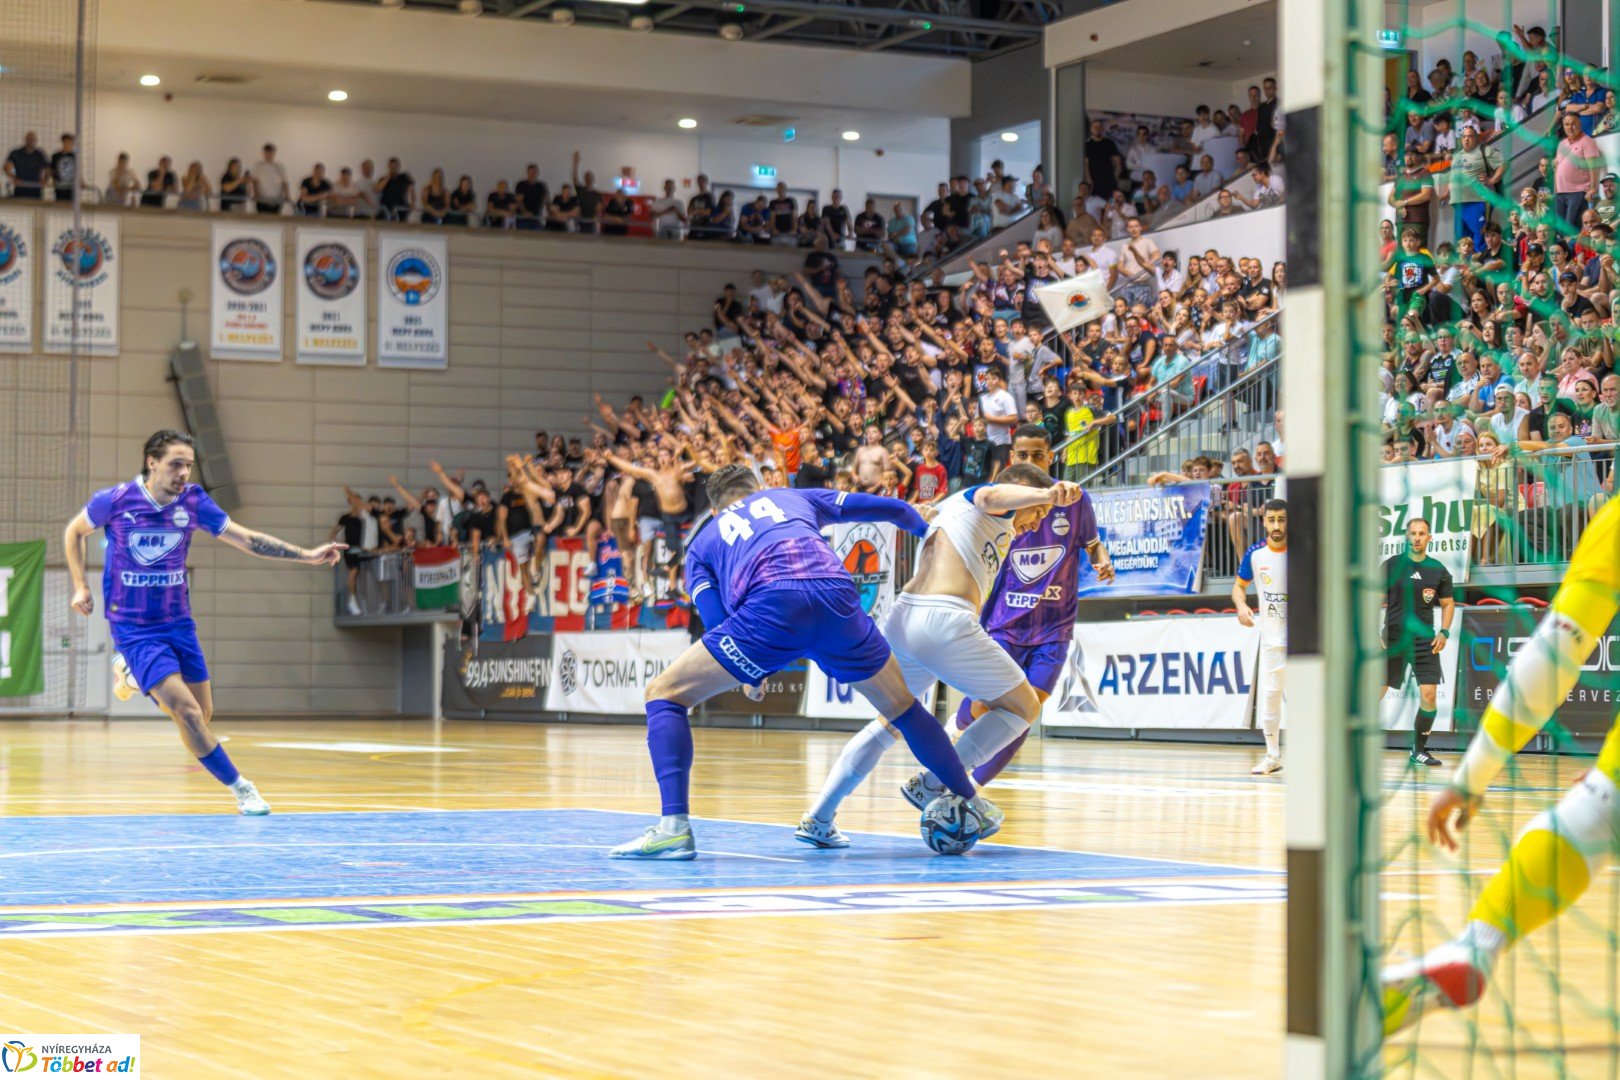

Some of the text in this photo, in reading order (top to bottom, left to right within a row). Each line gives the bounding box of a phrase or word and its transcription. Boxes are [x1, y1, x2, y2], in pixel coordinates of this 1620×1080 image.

[718, 496, 788, 547] 44
[1114, 495, 1126, 524] ÉS
[1164, 496, 1193, 520] KFT.
[138, 535, 166, 548] MOL
[842, 526, 885, 557] FUTSAL
[1020, 553, 1046, 566] MOL
[583, 659, 638, 688] TORMA
[1098, 651, 1250, 696] ARZENAL
